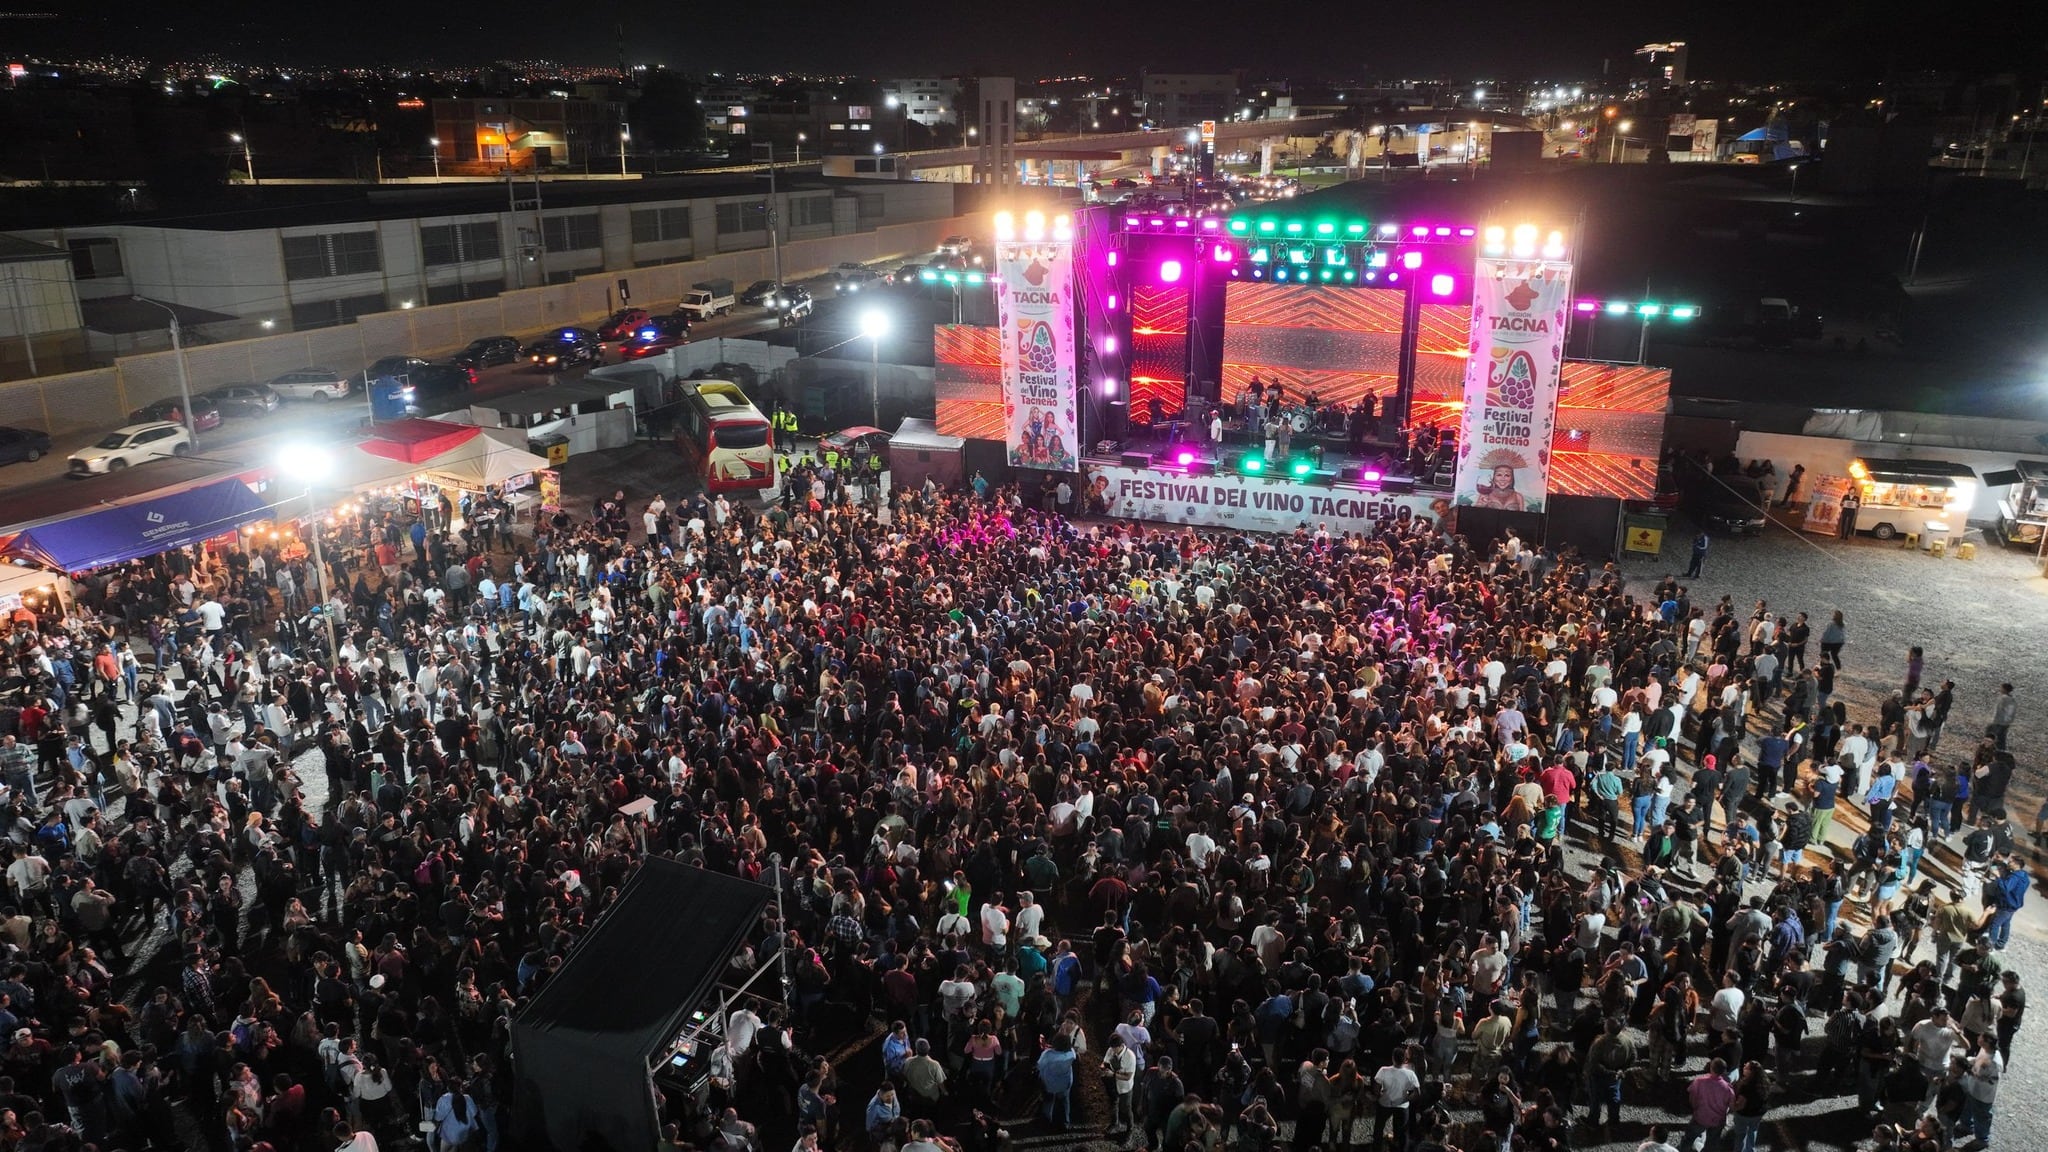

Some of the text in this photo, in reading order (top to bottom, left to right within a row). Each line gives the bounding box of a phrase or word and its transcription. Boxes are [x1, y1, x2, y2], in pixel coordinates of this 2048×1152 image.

[1012, 291, 1061, 304] TACNA
[1489, 316, 1548, 333] TACNA
[1019, 373, 1057, 386] Festival
[1029, 384, 1058, 399] Vino
[1020, 395, 1058, 407] Tacneño
[1484, 407, 1533, 424] Festival
[1483, 421, 1531, 438] del Vino
[1482, 433, 1530, 447] Tacneño
[1120, 479, 1412, 521] FESTIVAL DEL VINO TACNEÑO
